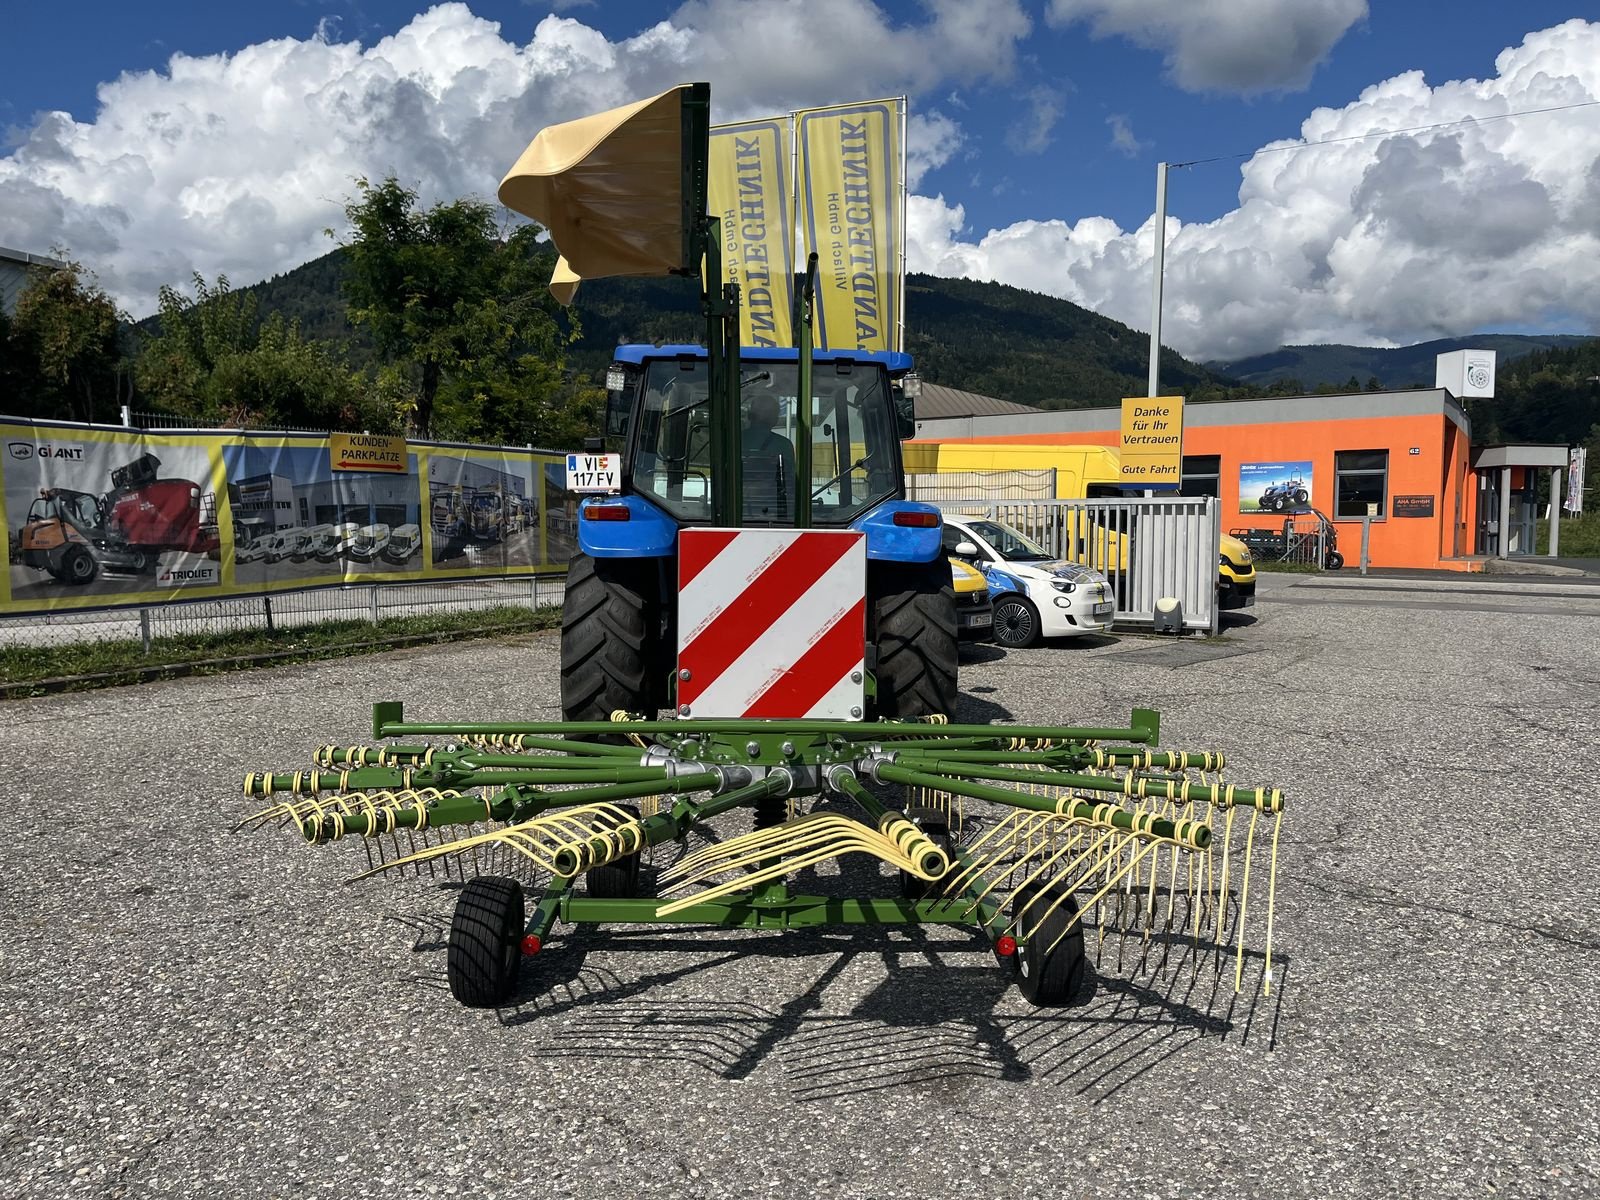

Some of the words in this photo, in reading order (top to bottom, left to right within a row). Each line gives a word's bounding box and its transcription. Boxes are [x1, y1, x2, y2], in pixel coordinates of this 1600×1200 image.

[1134, 406, 1170, 417] Danke
[1132, 420, 1149, 431] für
[1153, 420, 1169, 430] Ihr
[350, 436, 393, 448] KUNDEN-
[1123, 434, 1179, 445] Vertrauen
[341, 448, 400, 462] PARKPLÄTZE
[584, 457, 597, 471] VI
[1121, 464, 1146, 474] Gute
[1149, 464, 1177, 474] Fahrt
[573, 472, 594, 486] 117
[597, 472, 614, 486] FV
